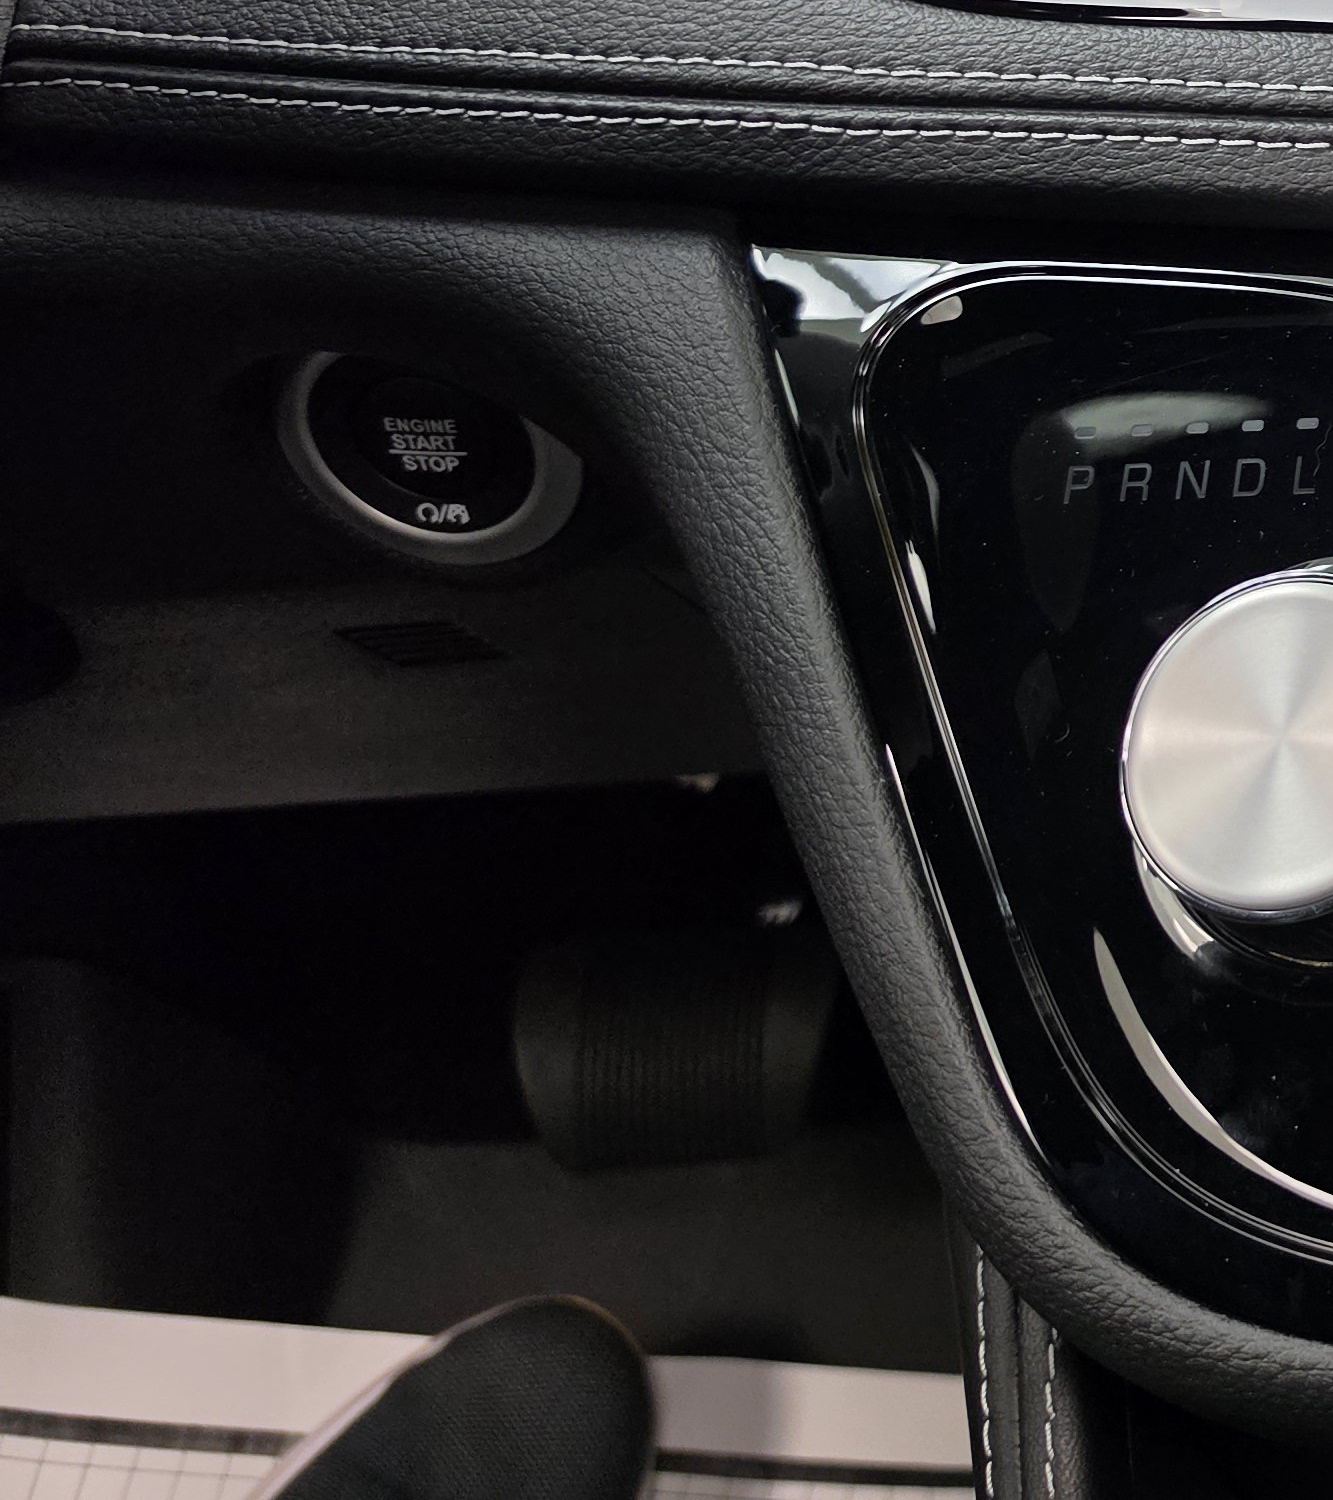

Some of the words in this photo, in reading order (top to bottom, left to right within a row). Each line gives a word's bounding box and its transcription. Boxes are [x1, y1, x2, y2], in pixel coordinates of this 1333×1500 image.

[383, 417, 458, 434] ENGINE
[389, 433, 457, 450] START
[402, 455, 460, 473] STOP
